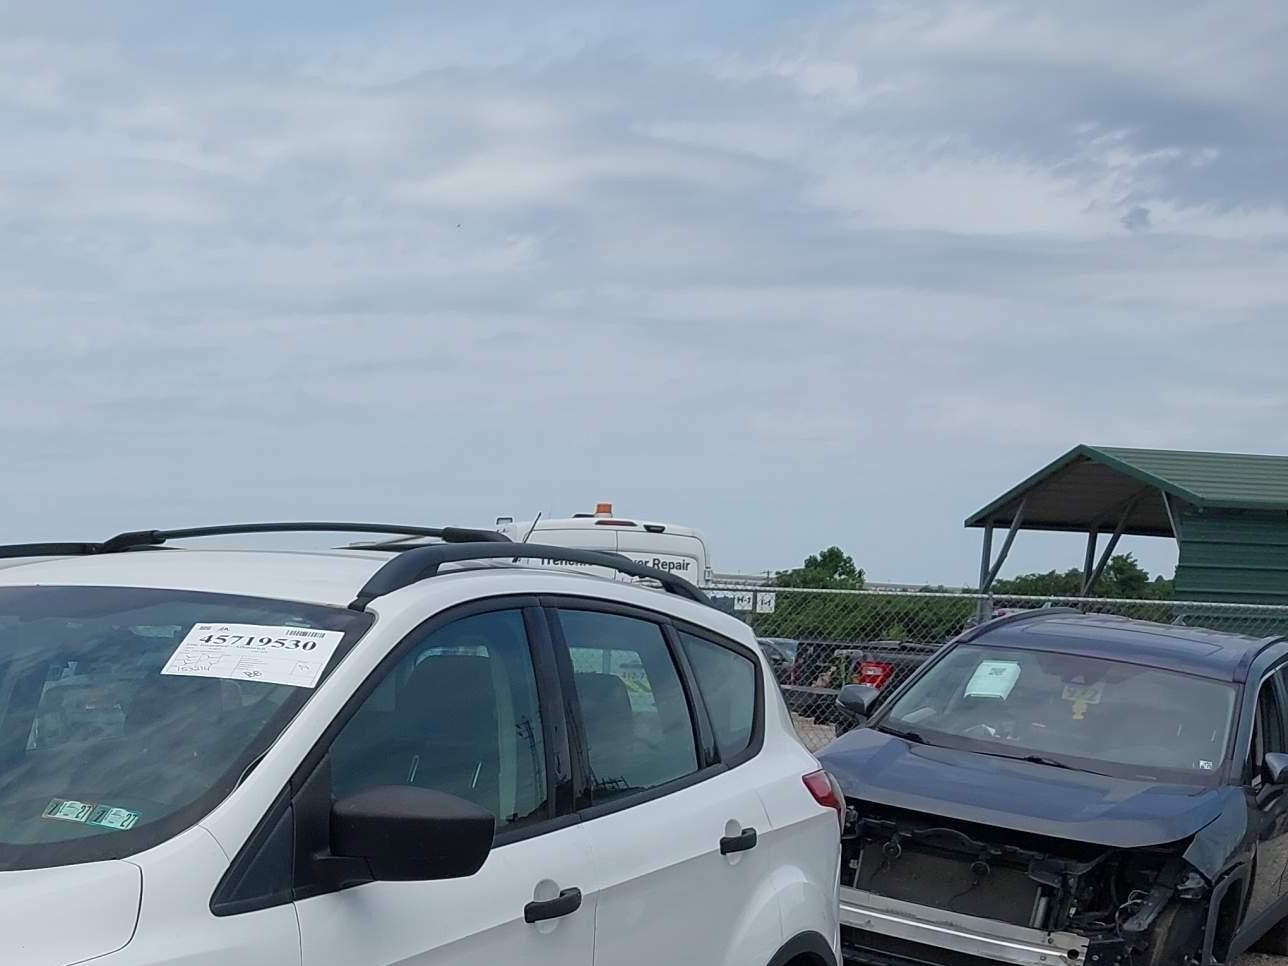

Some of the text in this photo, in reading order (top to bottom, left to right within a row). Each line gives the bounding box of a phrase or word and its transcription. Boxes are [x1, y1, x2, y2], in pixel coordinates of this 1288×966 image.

[652, 558, 691, 574] Repair
[199, 633, 318, 652] 45719530
[120, 813, 137, 828] 27
